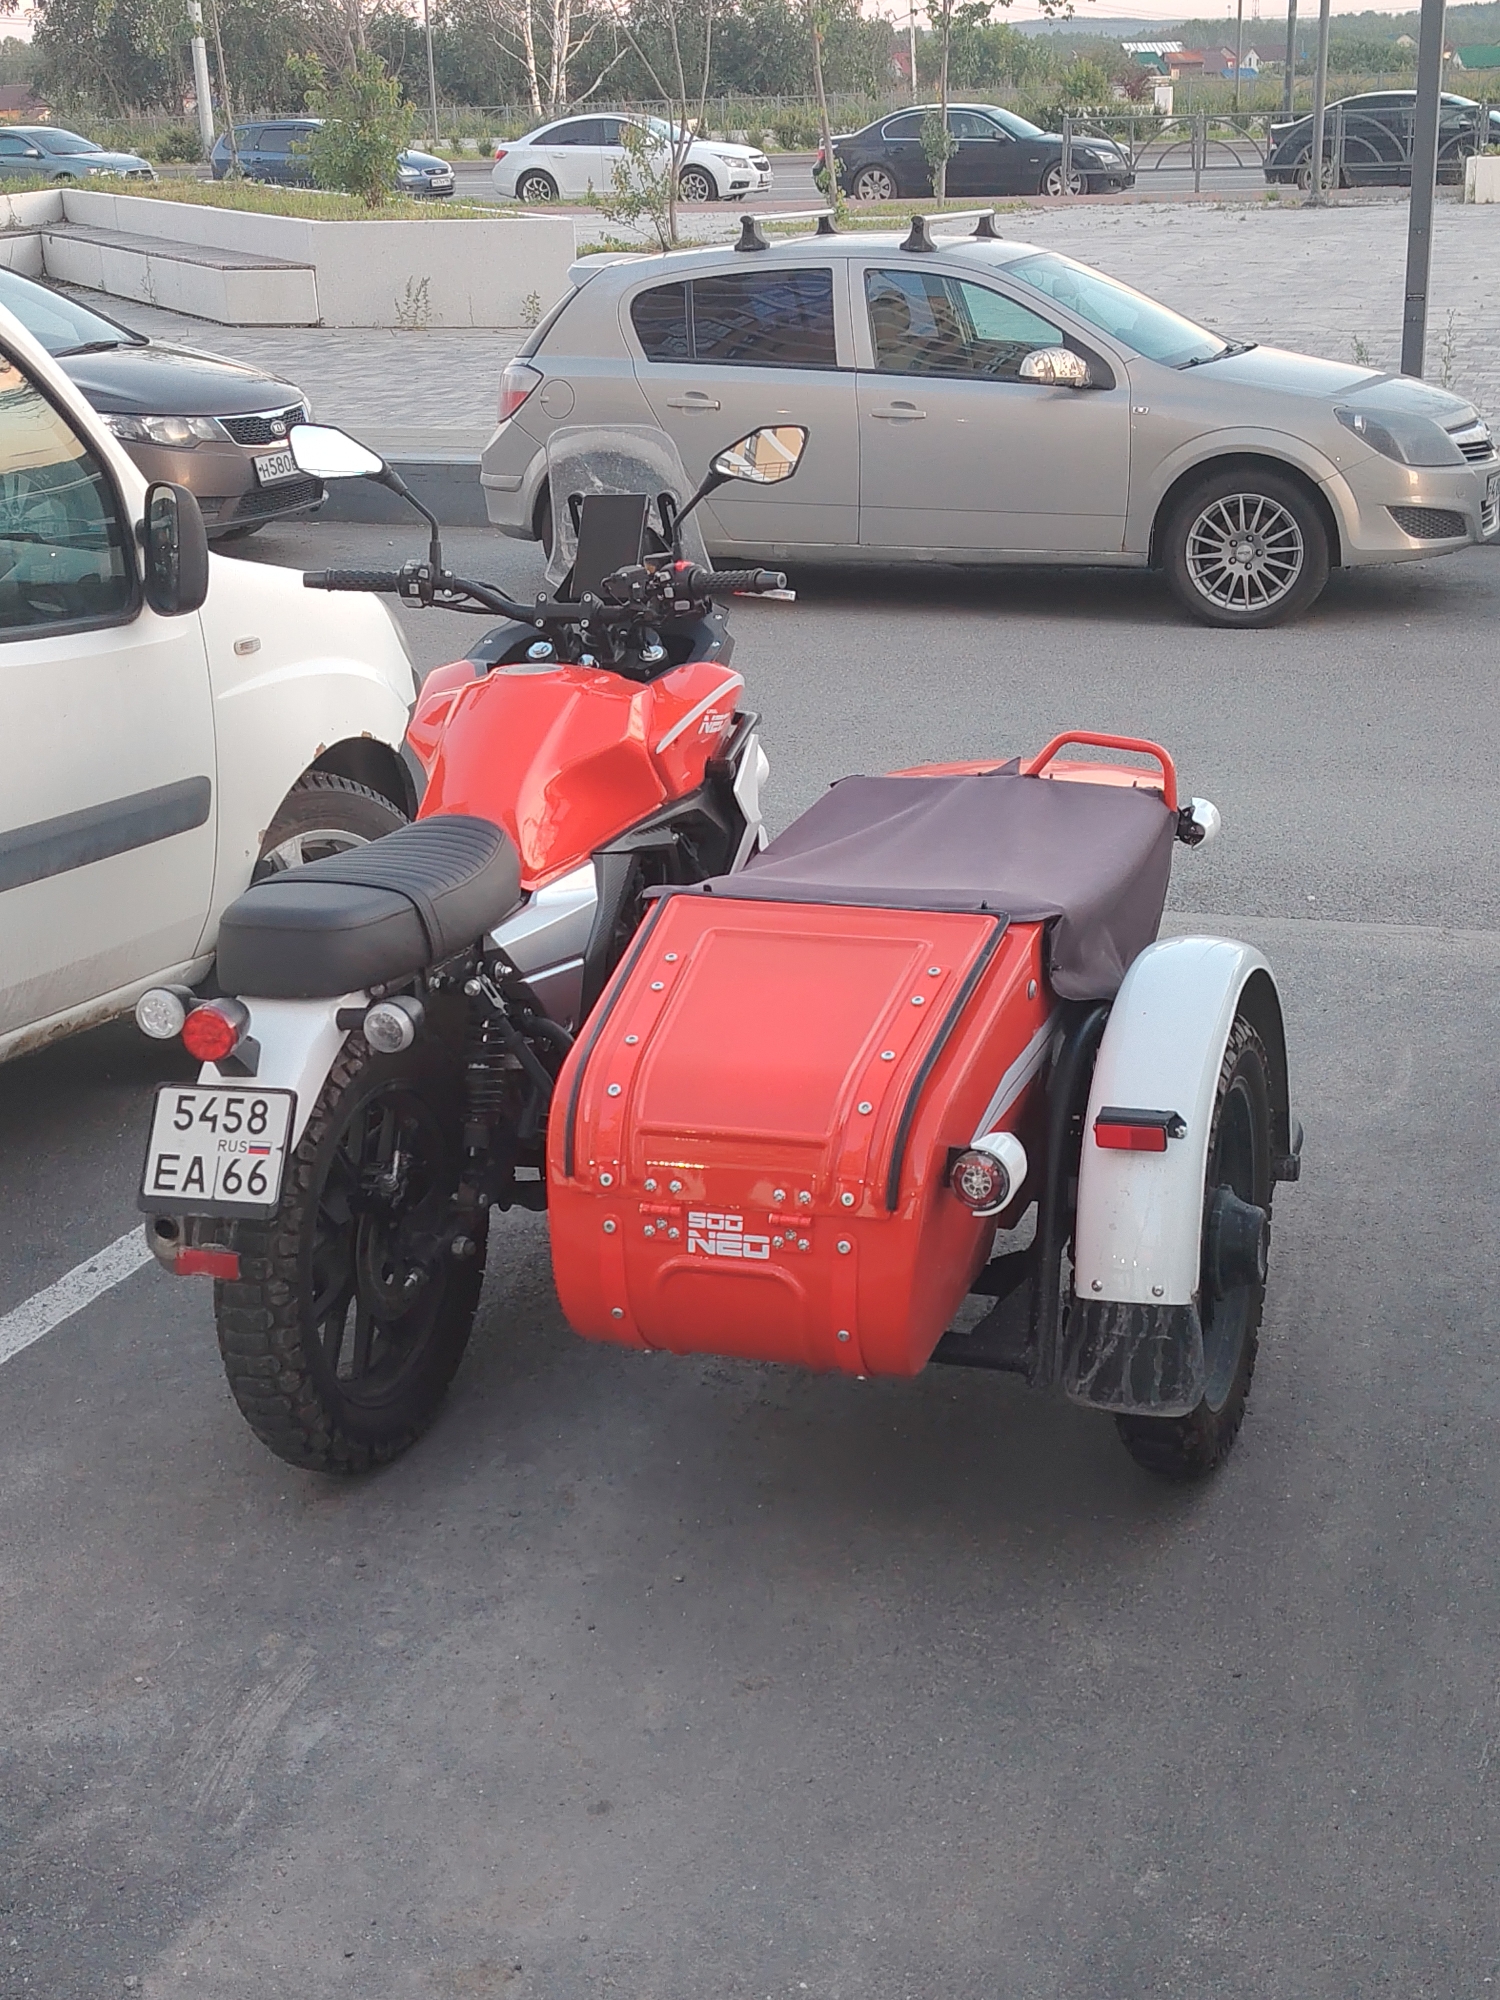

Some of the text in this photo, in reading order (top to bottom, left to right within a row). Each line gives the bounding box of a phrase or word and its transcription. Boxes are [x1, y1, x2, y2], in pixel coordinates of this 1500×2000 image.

[173, 1094, 268, 1135] 5458
[217, 1139, 248, 1153] RUS
[153, 1153, 267, 1196] EA 66
[687, 1229, 770, 1260] NEO
